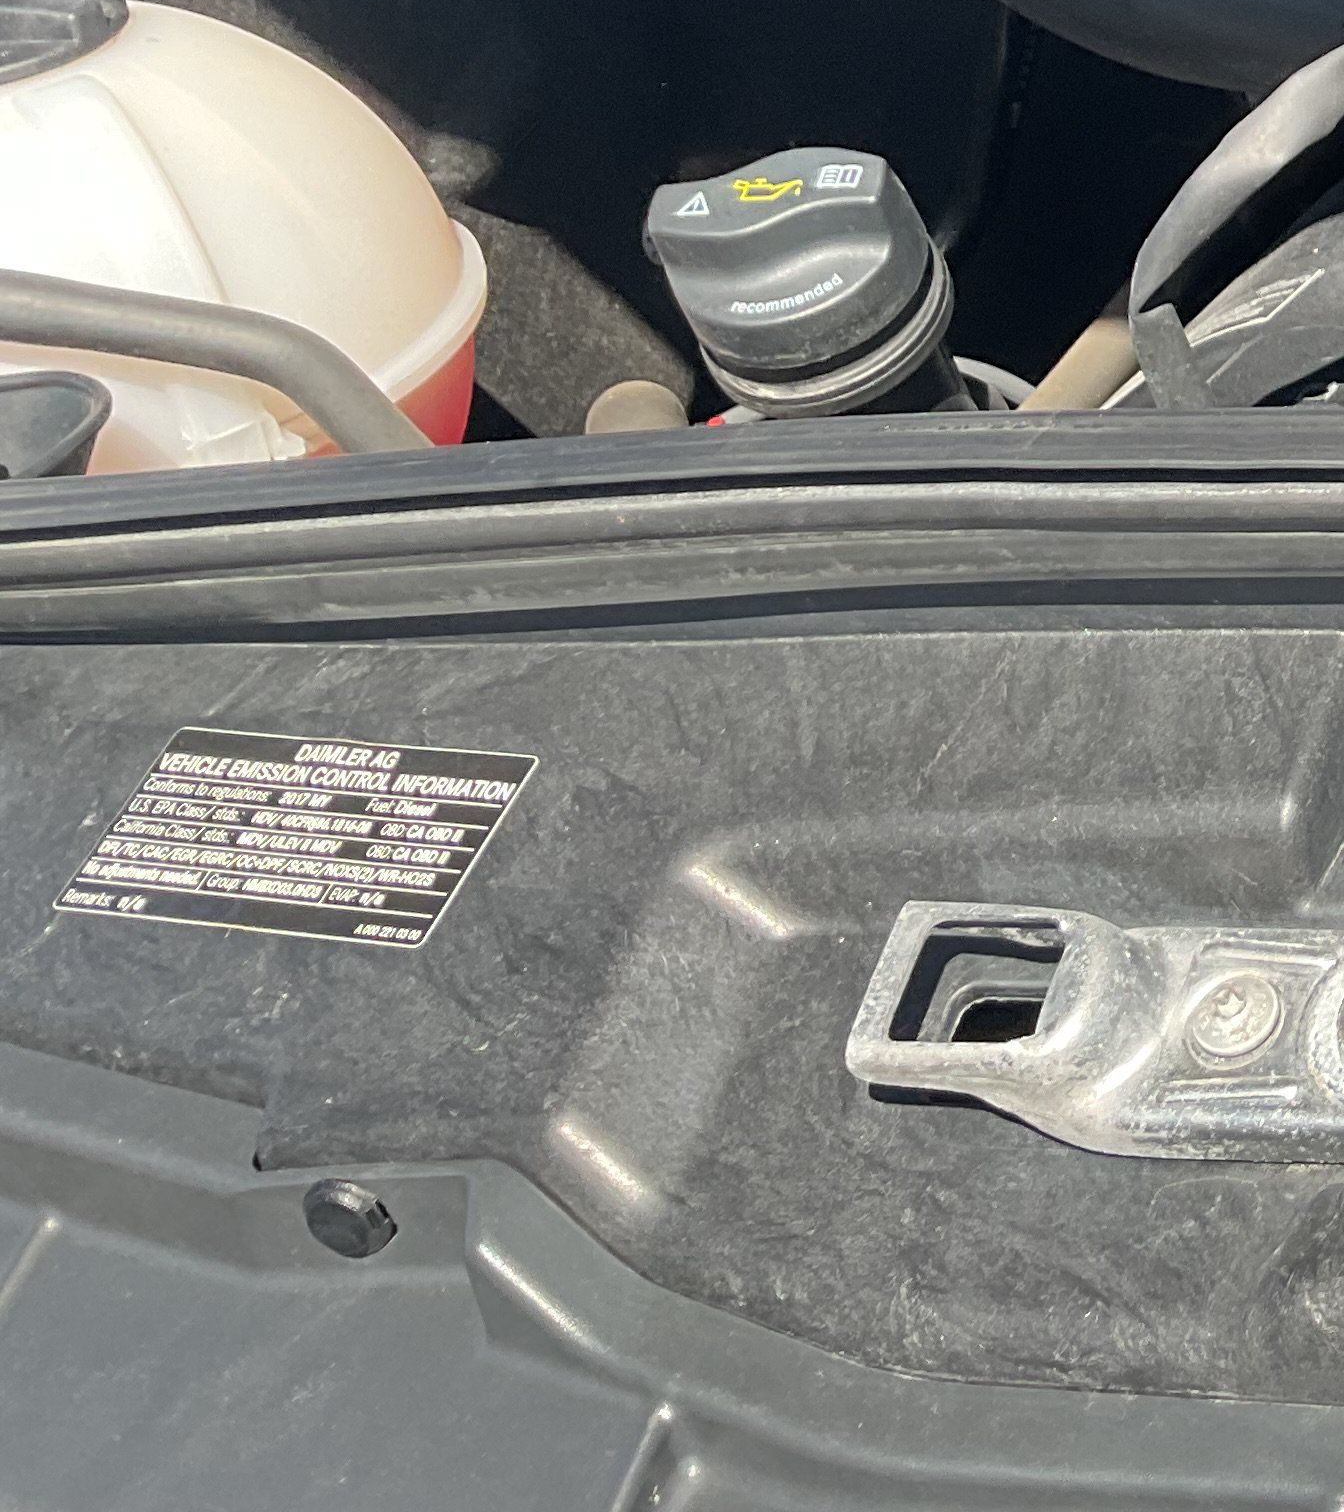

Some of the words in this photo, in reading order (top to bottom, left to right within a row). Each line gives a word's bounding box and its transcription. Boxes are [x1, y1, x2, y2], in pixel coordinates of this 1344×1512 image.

[729, 272, 844, 314] recommended
[294, 744, 373, 766] DAIMLER
[369, 752, 400, 769] AG
[142, 777, 196, 794] Conforms
[195, 782, 210, 796] to
[206, 784, 272, 804] regulations:
[279, 791, 309, 805] 2017
[394, 800, 437, 816] Diesel
[158, 753, 233, 778] VEHICLE
[226, 760, 314, 786] EMISSION
[309, 767, 393, 793] CONTROL
[391, 774, 517, 801] INFORMATION
[128, 799, 152, 812] U.S.
[151, 802, 176, 815] EPA
[174, 803, 214, 820] Class/
[379, 822, 406, 837] OBD:
[406, 825, 424, 838] CA
[424, 827, 452, 841] OBD
[113, 819, 165, 835] California
[164, 824, 203, 841] Class/
[310, 839, 341, 854] MDV
[365, 845, 392, 859] OBD:
[392, 847, 410, 860] CA
[410, 849, 437, 863] OBD
[82, 862, 100, 874] No
[63, 889, 115, 906] Remarks:
[354, 924, 363, 934] A
